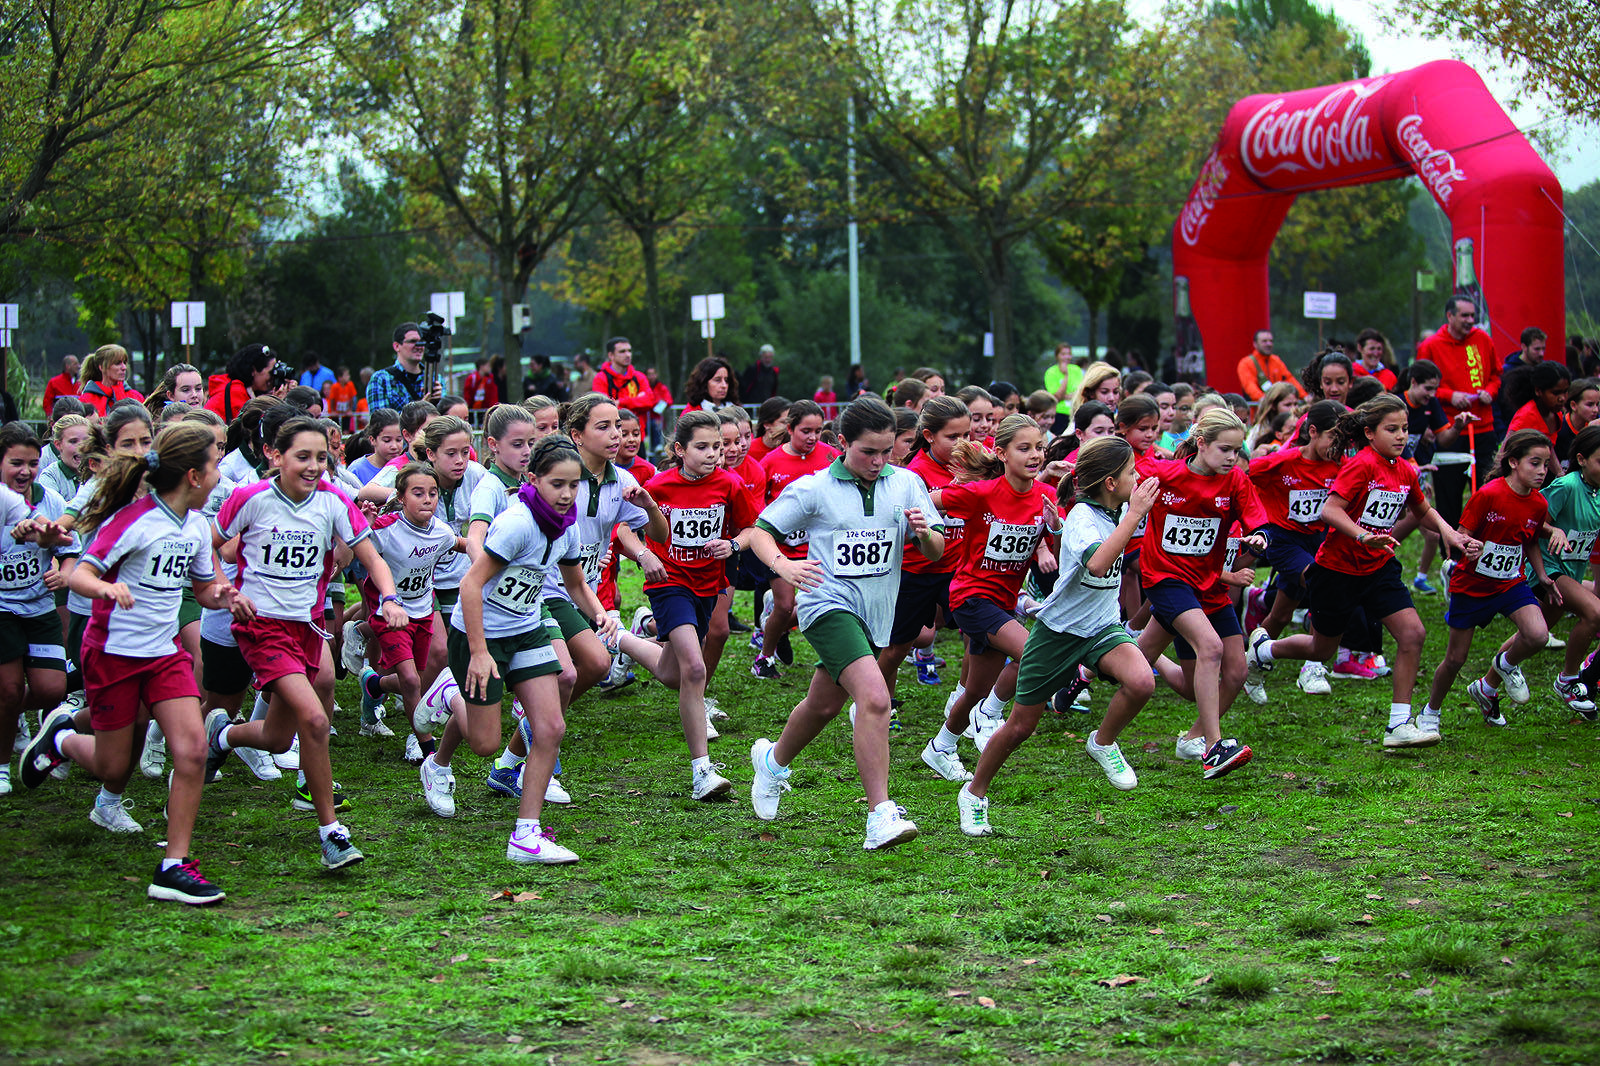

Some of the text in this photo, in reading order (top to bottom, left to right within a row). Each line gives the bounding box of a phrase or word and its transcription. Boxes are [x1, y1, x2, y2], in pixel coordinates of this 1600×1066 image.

[673, 517, 720, 538] 4364
[1165, 527, 1215, 546] 4373
[261, 544, 319, 568] 1452
[837, 541, 892, 566] 3687
[1481, 552, 1520, 572] 4361
[0, 557, 41, 582] 693
